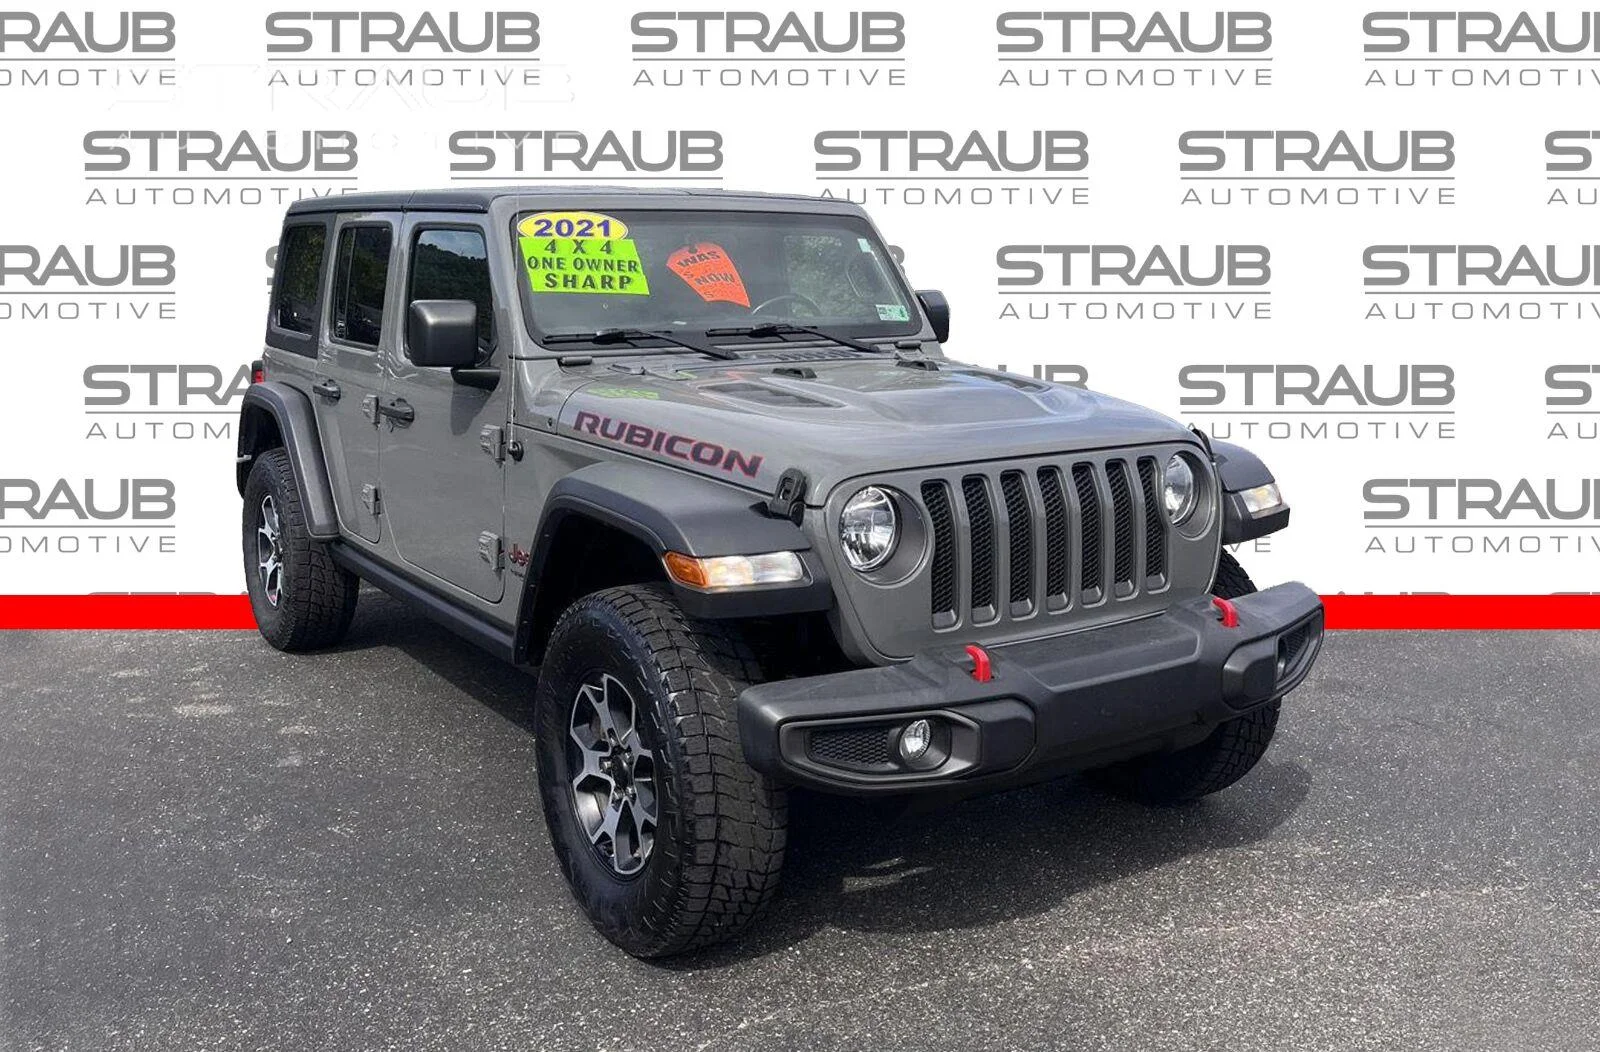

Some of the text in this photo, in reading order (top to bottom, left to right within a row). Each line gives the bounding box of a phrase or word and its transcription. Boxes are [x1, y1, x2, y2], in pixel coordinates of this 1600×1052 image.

[266, 11, 541, 53] STRAUB
[631, 11, 906, 53] STRAUB
[996, 11, 1271, 53] STRAUB
[1363, 11, 1600, 53] STRAU
[268, 69, 540, 86] AUTOMOTIVE
[633, 69, 905, 86] AUTOMOTIVE
[999, 69, 1271, 86] AUTOMOTIVE
[83, 130, 358, 172] STRAUB
[449, 130, 723, 172] STRAUB
[814, 130, 1089, 172] STRAUB
[1180, 130, 1455, 172] STRAUB
[1181, 188, 1455, 205] AUTOMOTIVE
[533, 218, 612, 238] 2021
[544, 239, 612, 255] 4 X 4
[527, 255, 639, 274] ONE OWNER
[676, 250, 721, 268] WAS
[694, 271, 736, 287] NOW
[997, 245, 1271, 286] STRAUB
[1363, 245, 1600, 286] STRAU
[544, 272, 633, 291] SHARP
[999, 303, 1271, 319] AUTOMOTIVE
[1179, 364, 1455, 406] STRAUB
[573, 410, 763, 478] RUBICON
[1363, 478, 1600, 520] STRAU
